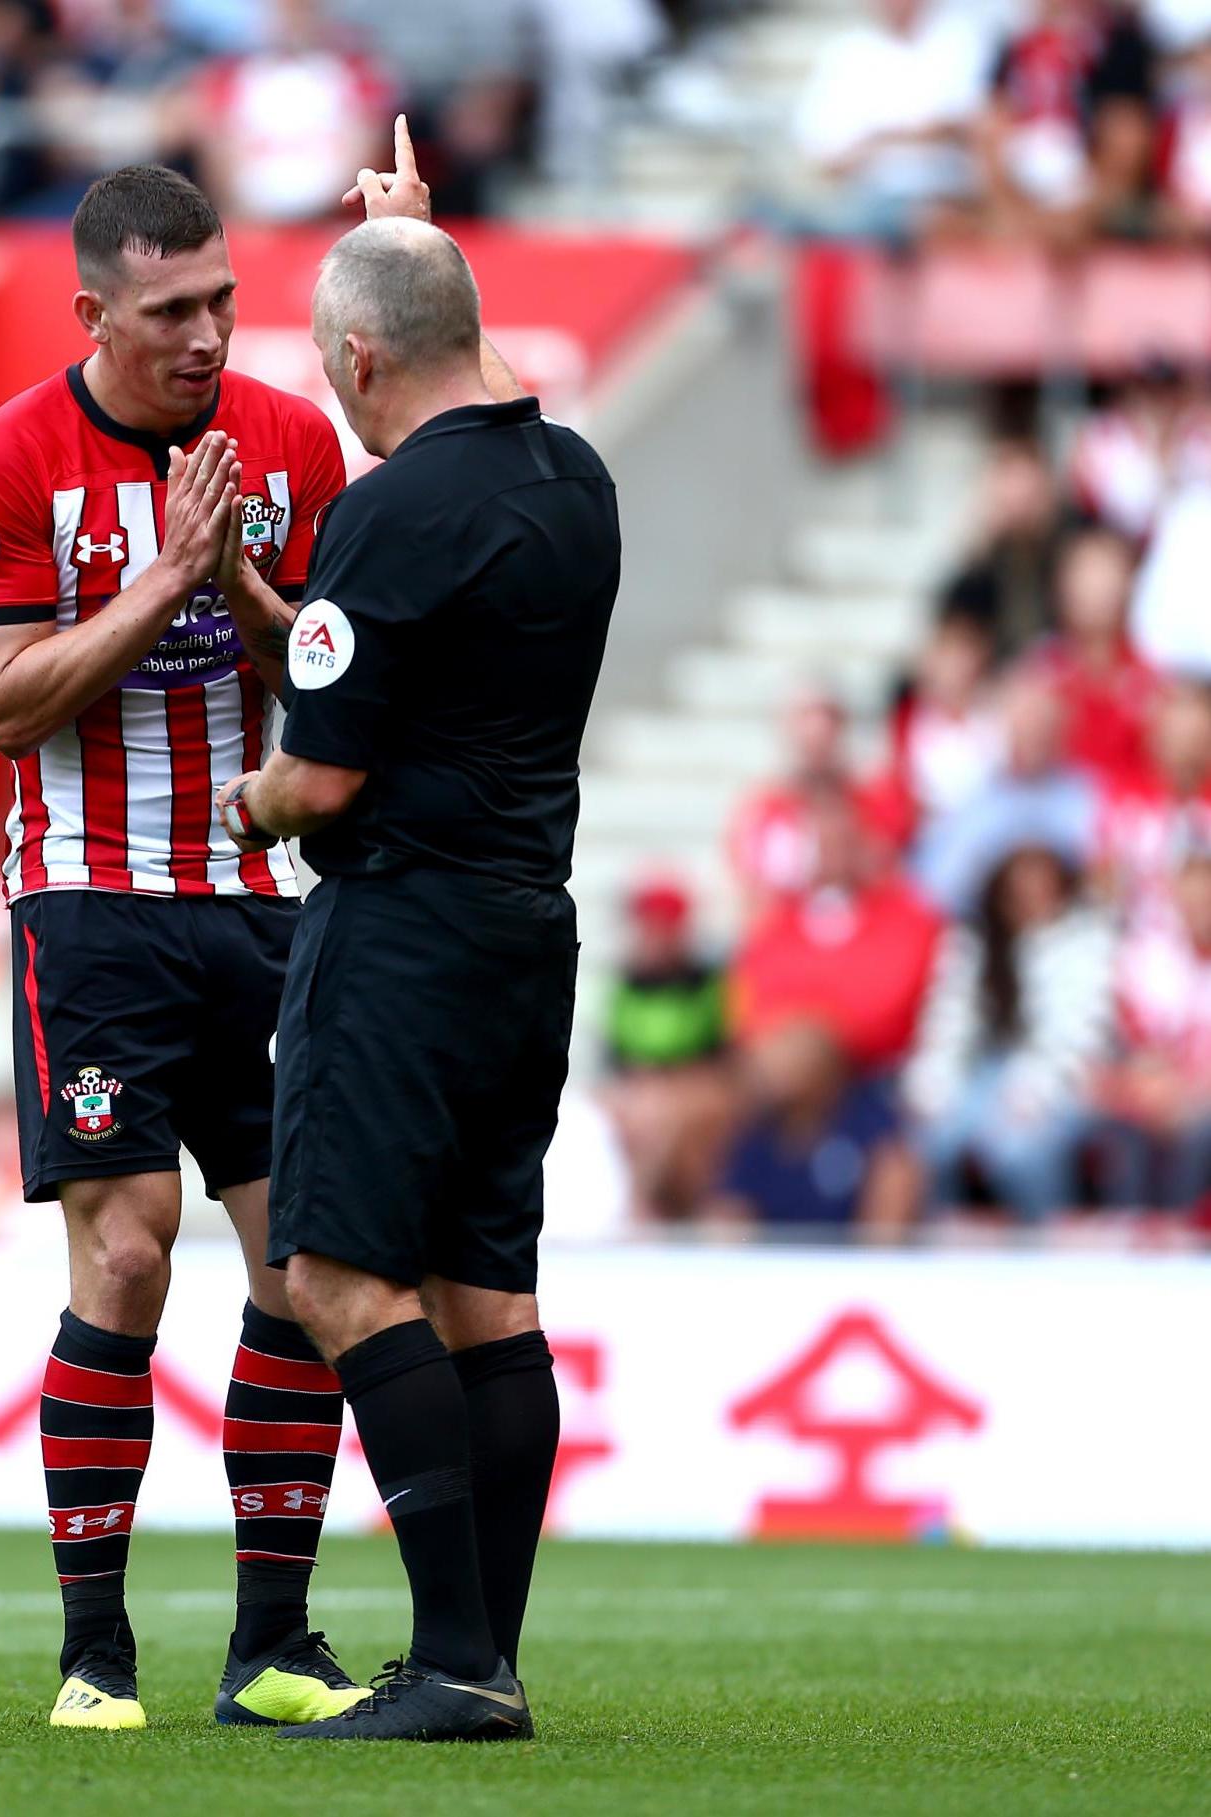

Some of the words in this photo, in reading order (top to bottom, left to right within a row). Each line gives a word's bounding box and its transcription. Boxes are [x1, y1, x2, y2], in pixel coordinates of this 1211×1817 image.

[216, 628, 234, 643] for
[297, 619, 335, 653] EA
[189, 650, 235, 672] people
[68, 1127, 112, 1141] SOUTHAMPTON
[111, 1122, 122, 1132] FC
